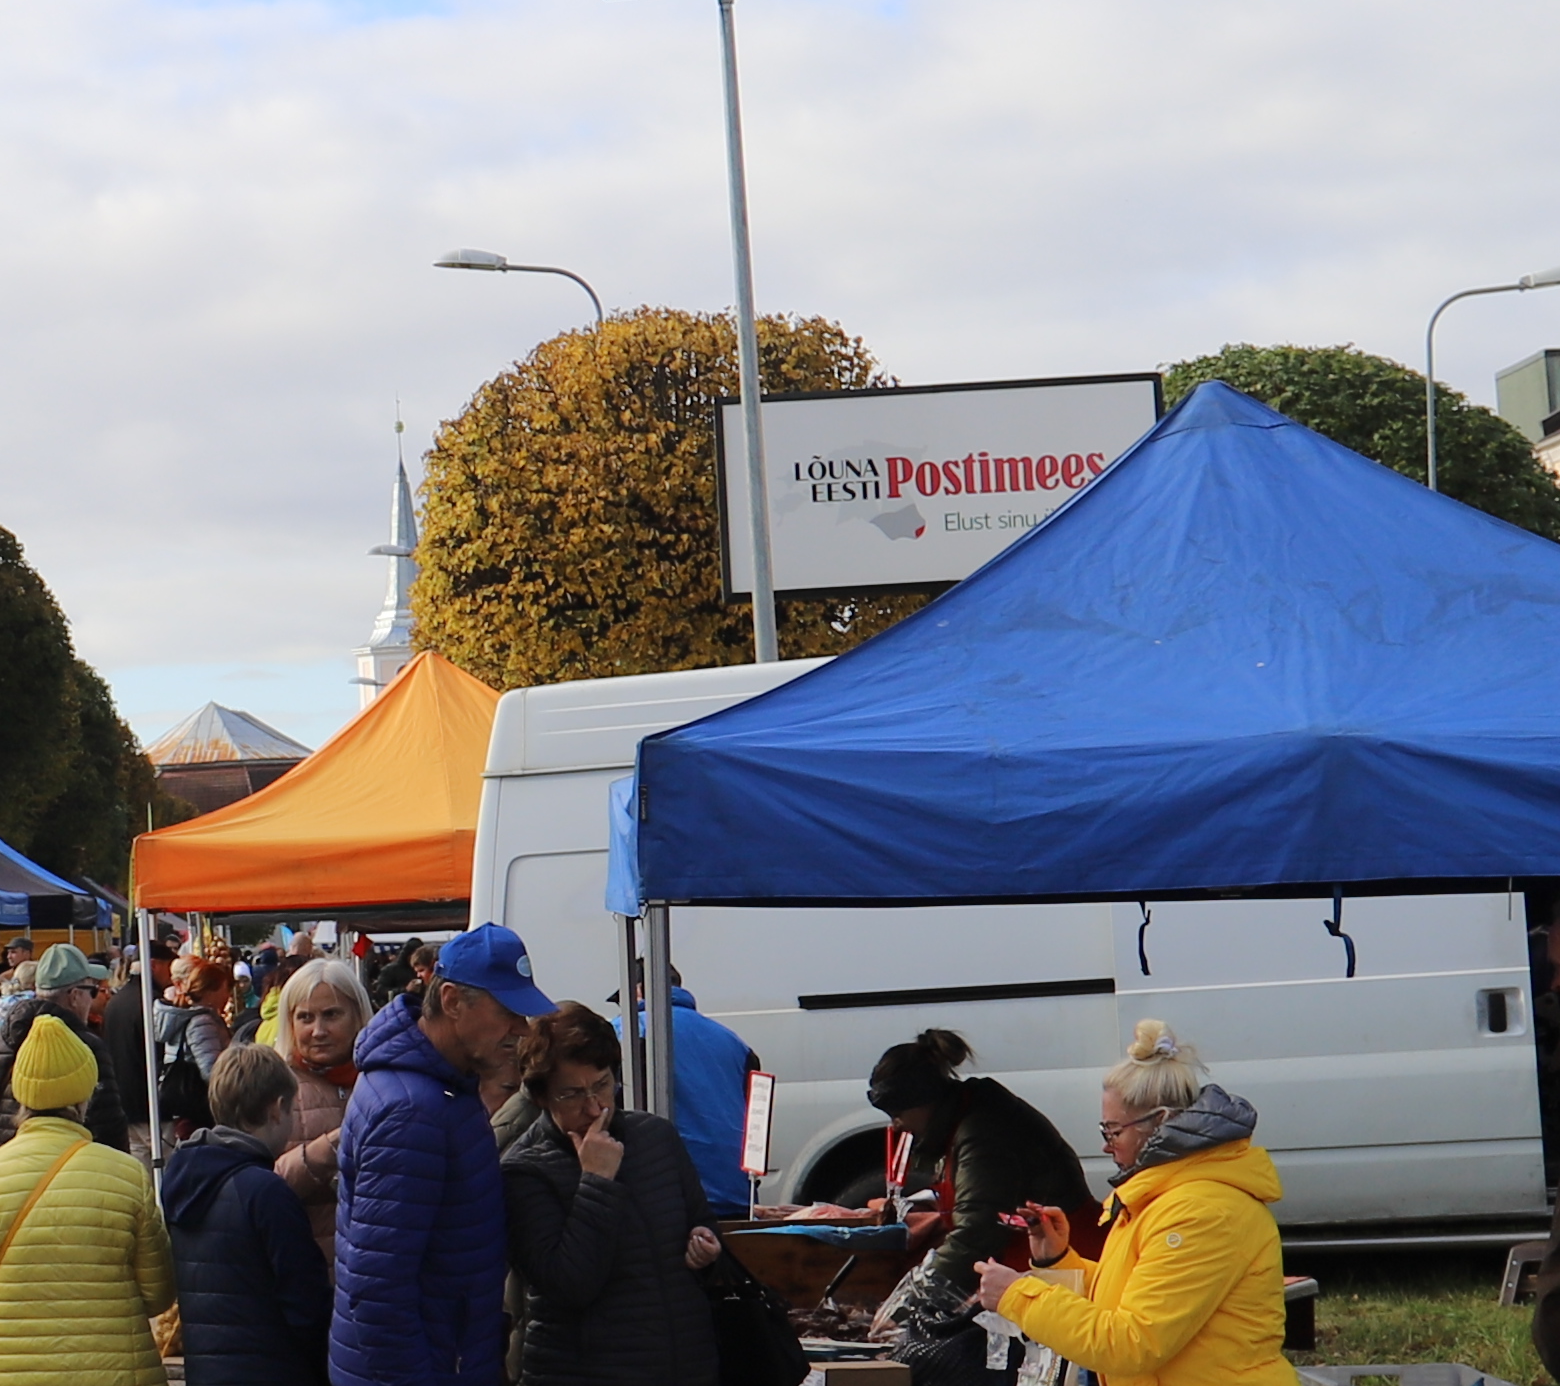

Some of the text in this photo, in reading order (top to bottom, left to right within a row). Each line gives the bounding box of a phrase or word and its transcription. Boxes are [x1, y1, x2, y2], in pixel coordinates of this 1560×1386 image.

[794, 455, 879, 482] LÕUNA
[884, 451, 1106, 500] Postimees
[811, 480, 880, 503] EESTI
[944, 511, 992, 532] Elust
[998, 510, 1037, 530] sinu
